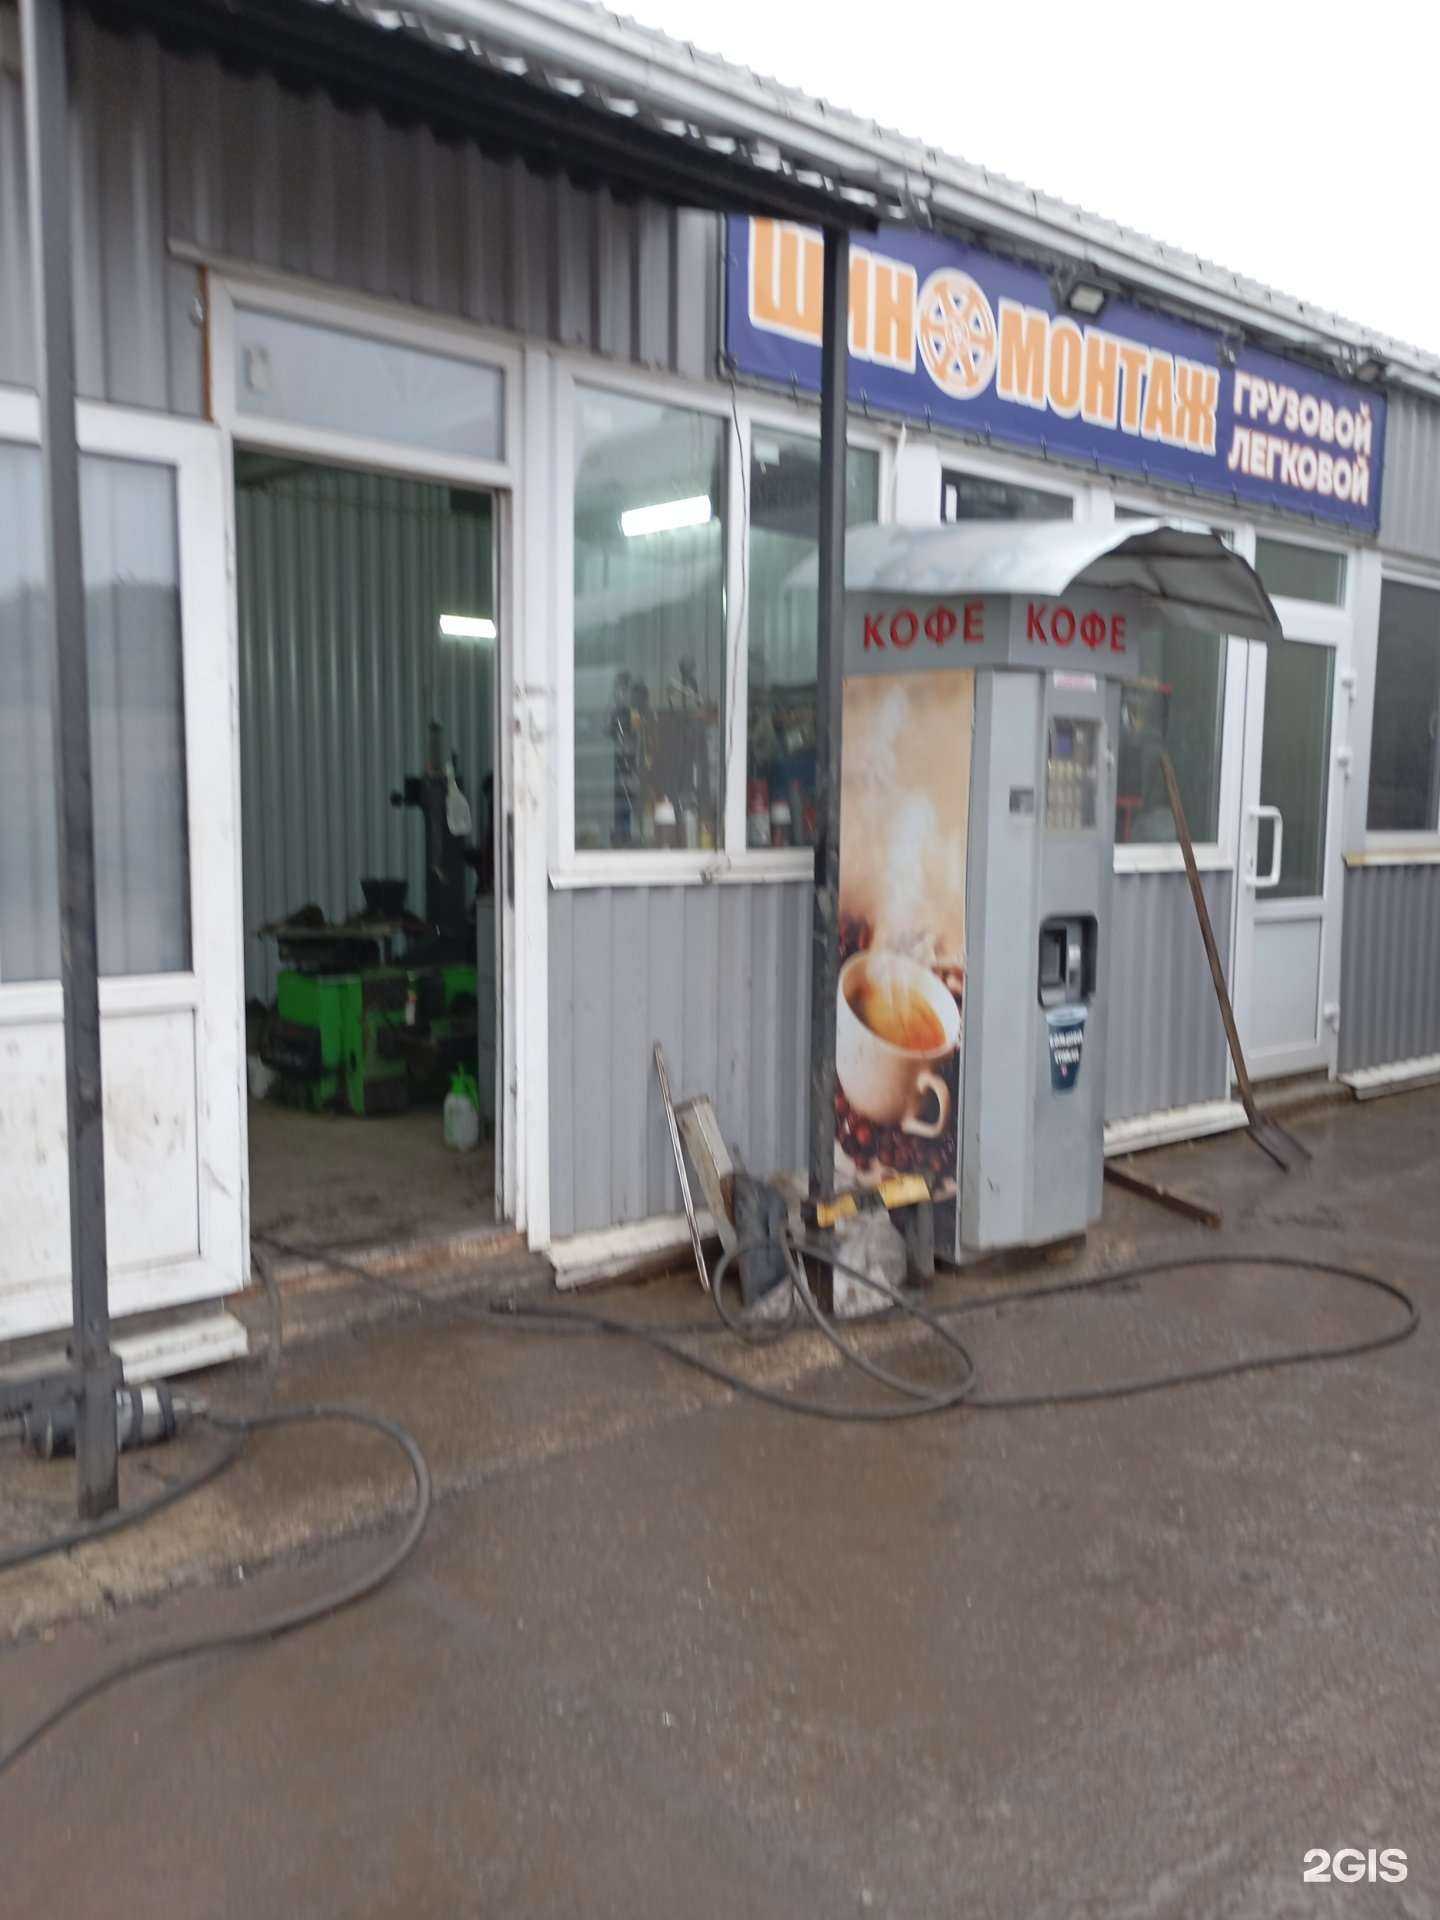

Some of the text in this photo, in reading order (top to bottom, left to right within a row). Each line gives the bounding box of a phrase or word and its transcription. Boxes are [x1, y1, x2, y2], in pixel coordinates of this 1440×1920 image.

[1233, 369, 1372, 456] ГРУЗОВОЙ
[1228, 424, 1369, 507] ЛЕГКОВОЙ
[862, 600, 986, 651] КОФЕ
[1026, 602, 1128, 653] КОФЕ
